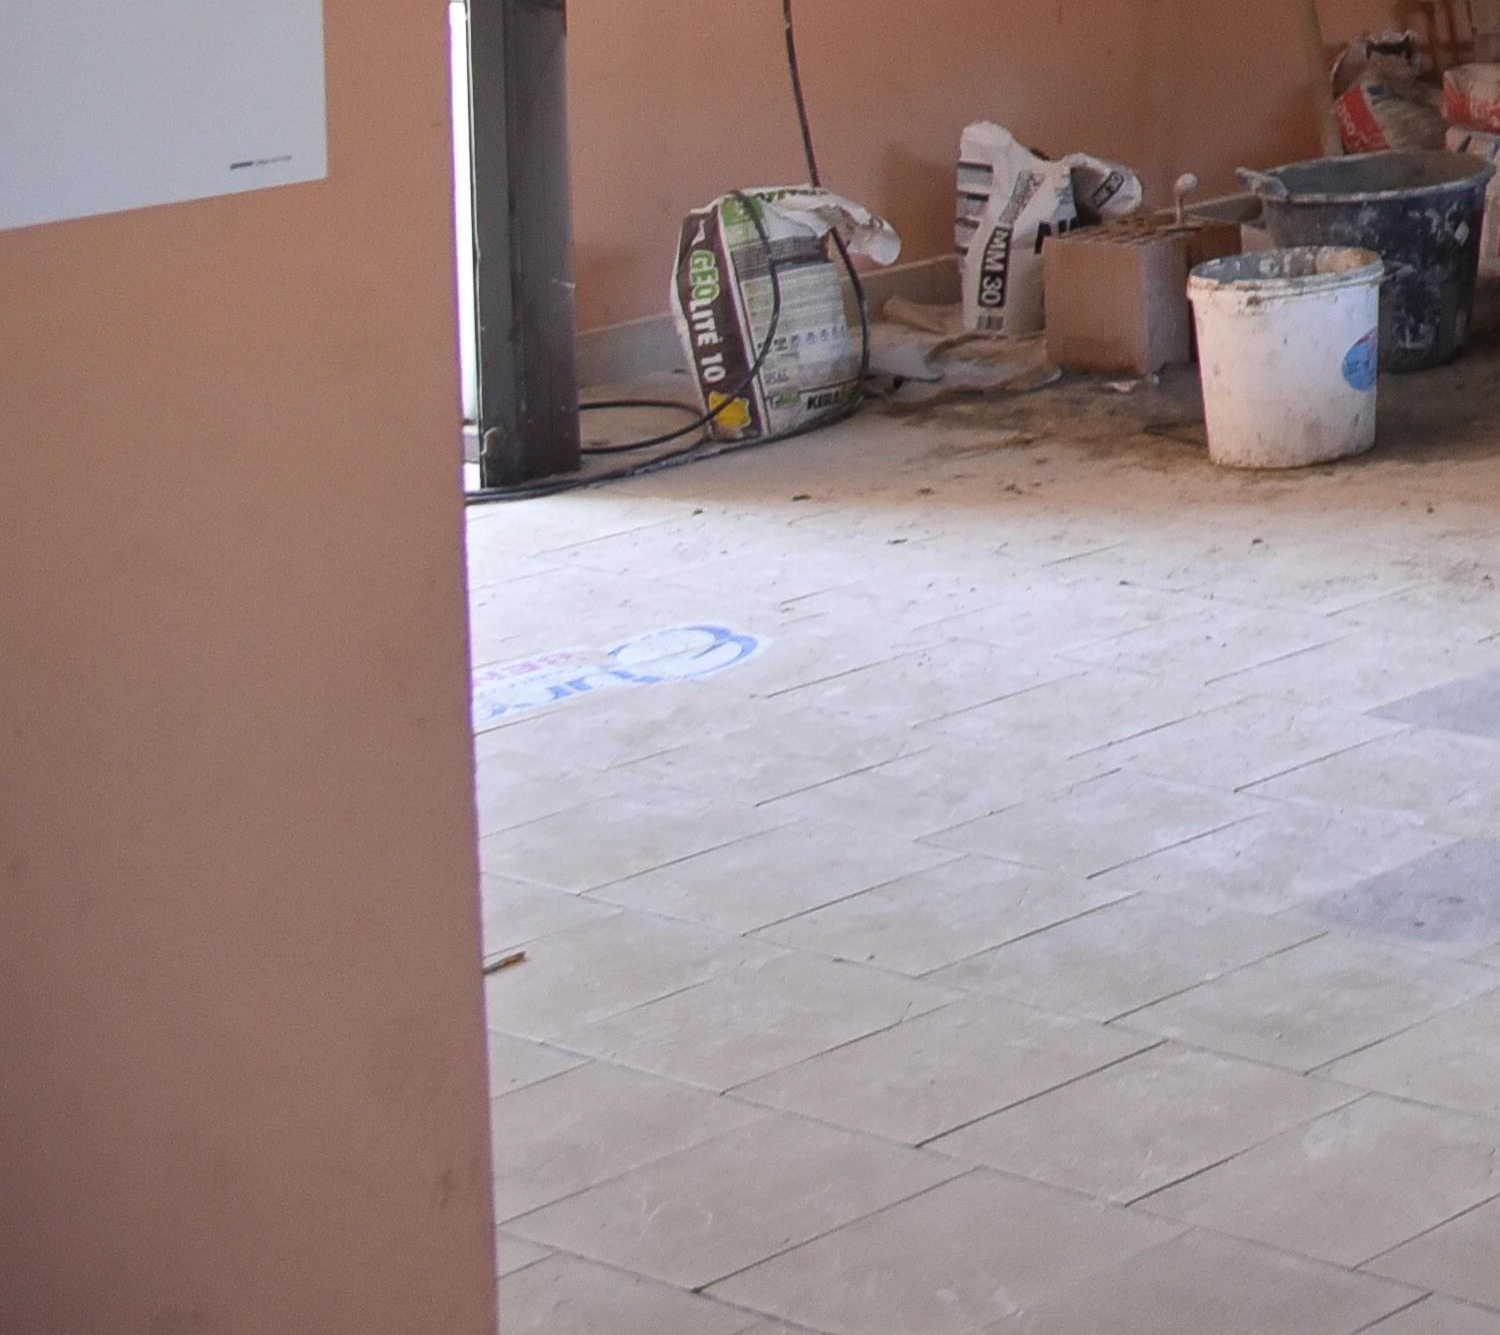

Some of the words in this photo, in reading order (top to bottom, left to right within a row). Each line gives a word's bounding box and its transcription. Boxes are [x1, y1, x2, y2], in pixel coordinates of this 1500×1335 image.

[983, 228, 1010, 272] MM
[980, 275, 1004, 304] 30
[700, 355, 727, 384] 10
